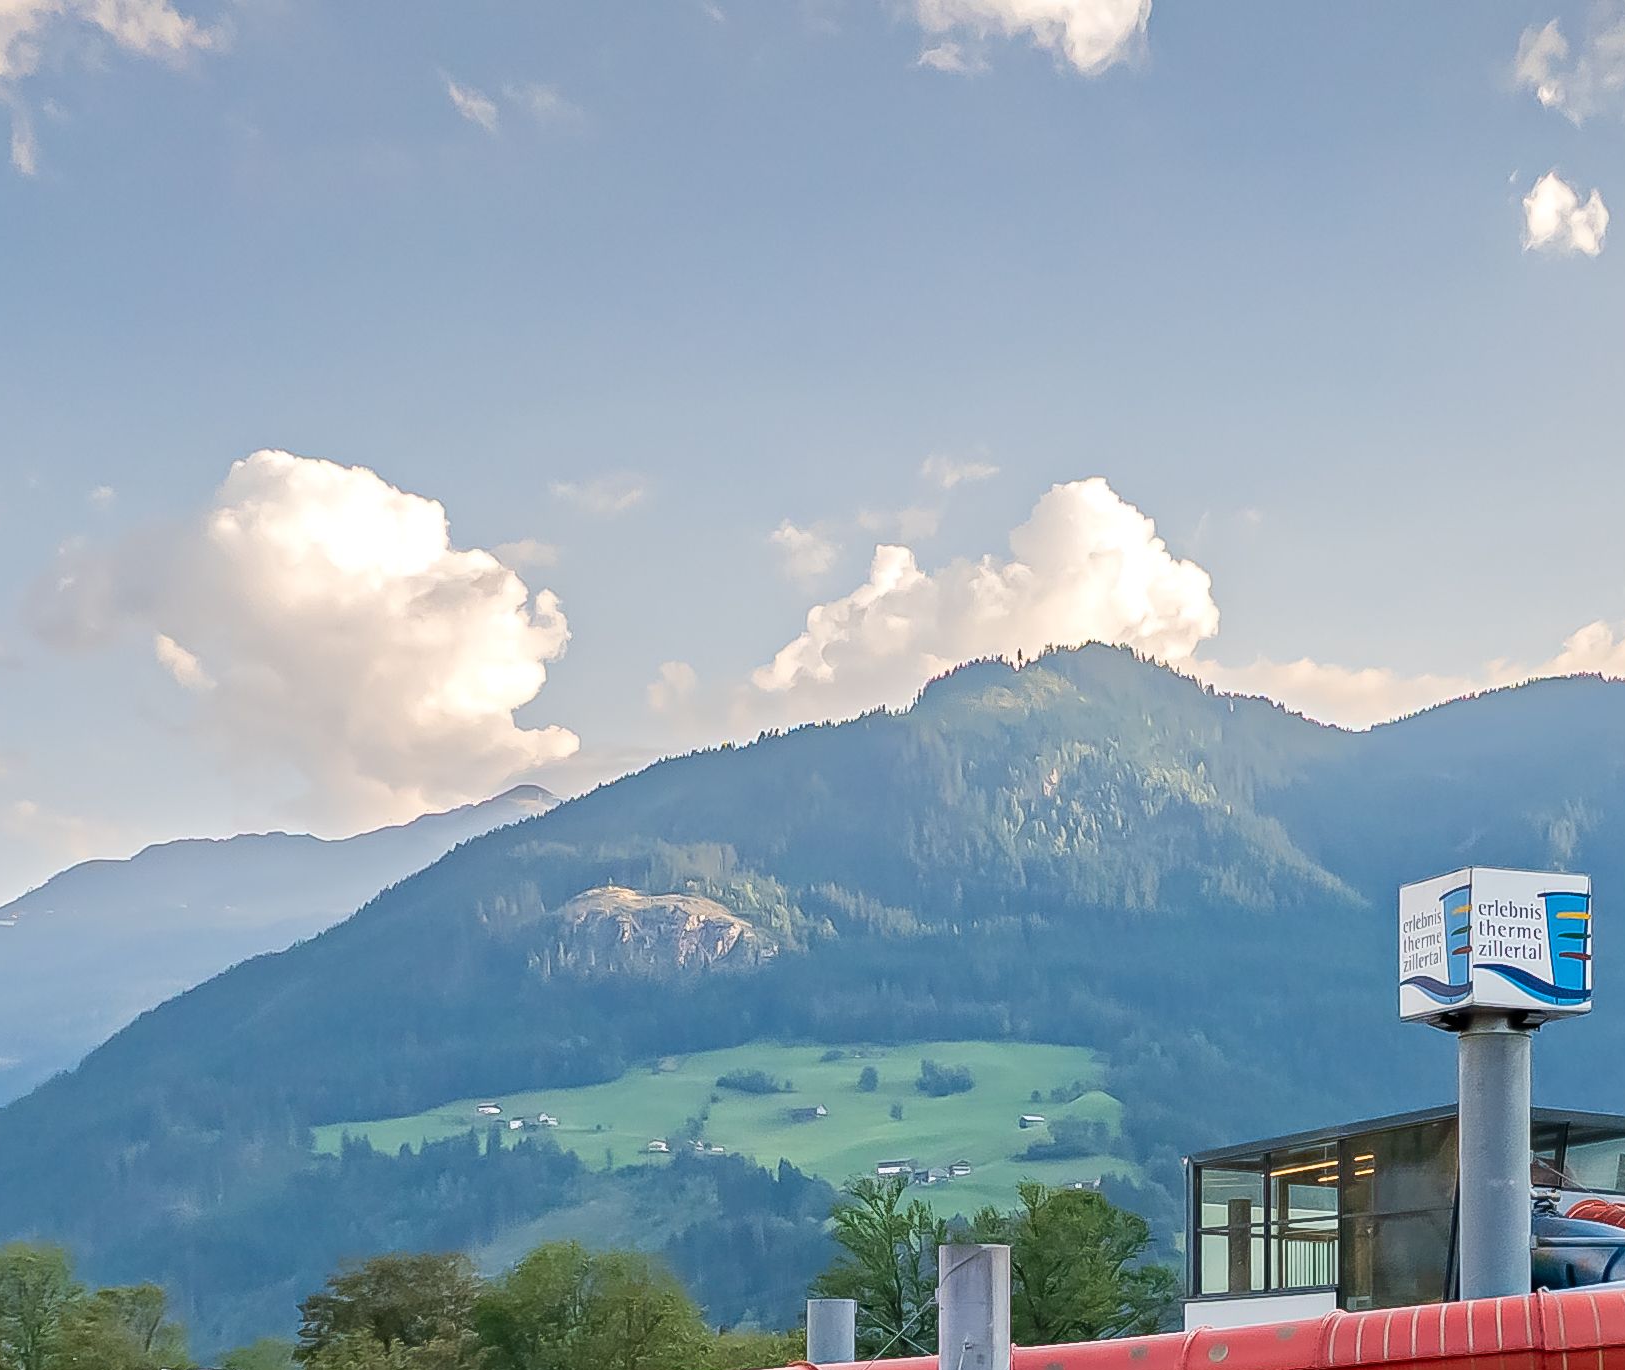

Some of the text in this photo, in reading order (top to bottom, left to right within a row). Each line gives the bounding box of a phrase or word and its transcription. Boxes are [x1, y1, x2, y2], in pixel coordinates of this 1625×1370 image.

[1403, 908, 1442, 933] erlebnis
[1478, 899, 1542, 920] erlebnis
[1479, 919, 1543, 941] therme
[1403, 932, 1442, 953] therme
[1478, 939, 1542, 961] zillertal
[1403, 946, 1442, 972] zillertal
